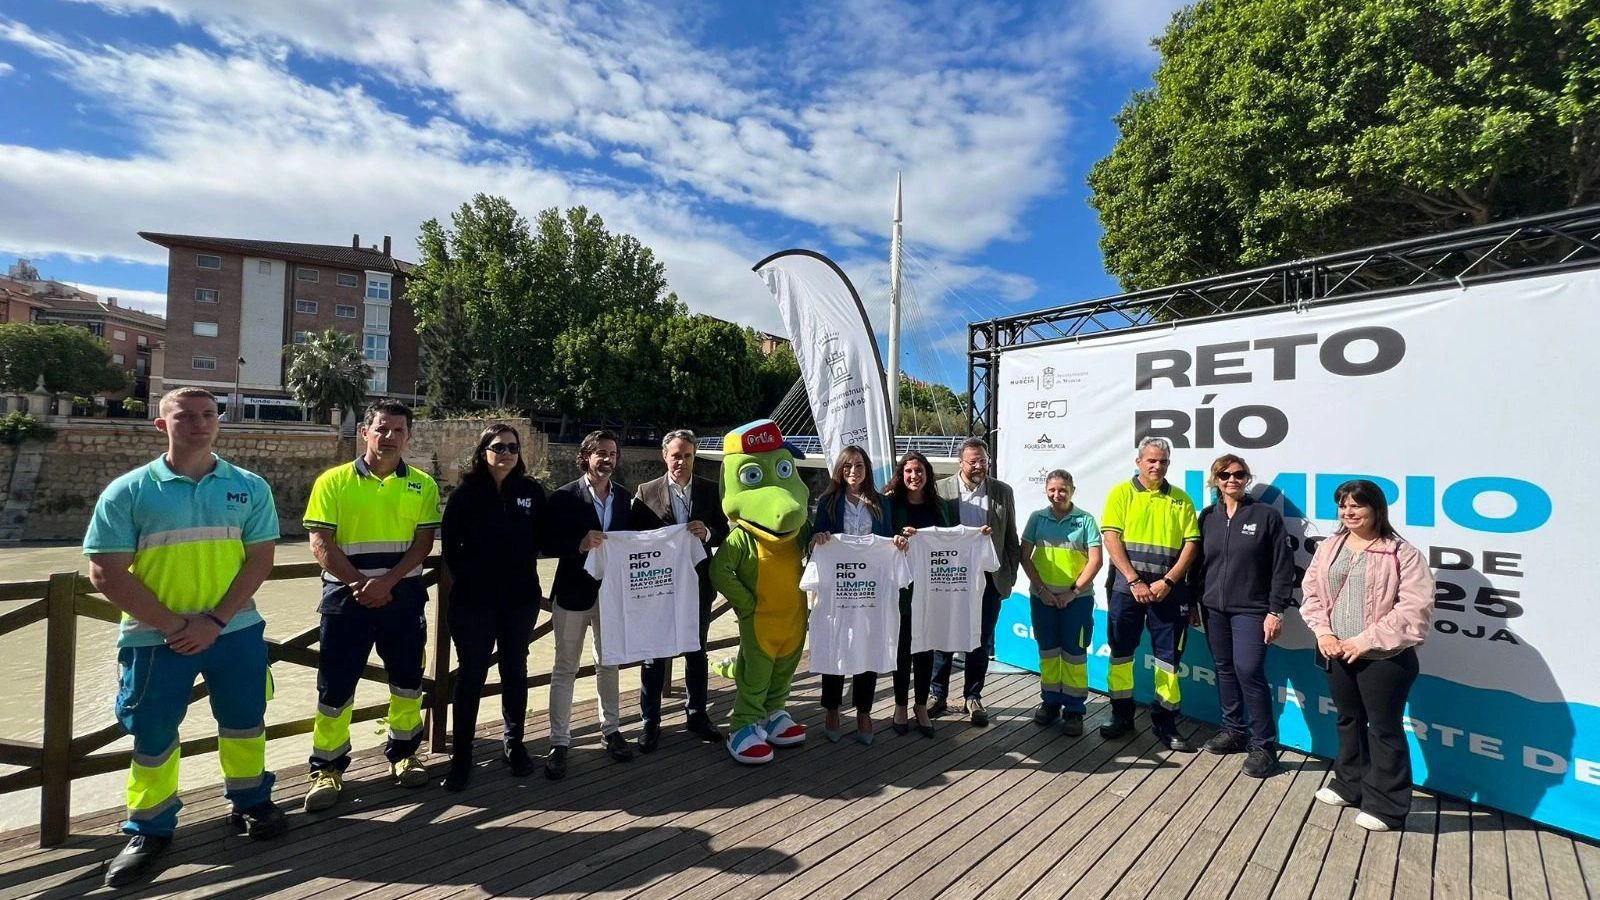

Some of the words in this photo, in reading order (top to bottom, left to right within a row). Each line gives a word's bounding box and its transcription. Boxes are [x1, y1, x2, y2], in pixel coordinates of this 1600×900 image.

[1135, 326, 1406, 390] RETO
[1027, 400, 1048, 411] pre
[1027, 410, 1056, 419] zero
[1134, 393, 1289, 450] RÍO
[629, 551, 661, 560] RETO
[1429, 546, 1523, 577] DE
[630, 568, 672, 578] LIMPIO
[836, 570, 856, 579] RÍO
